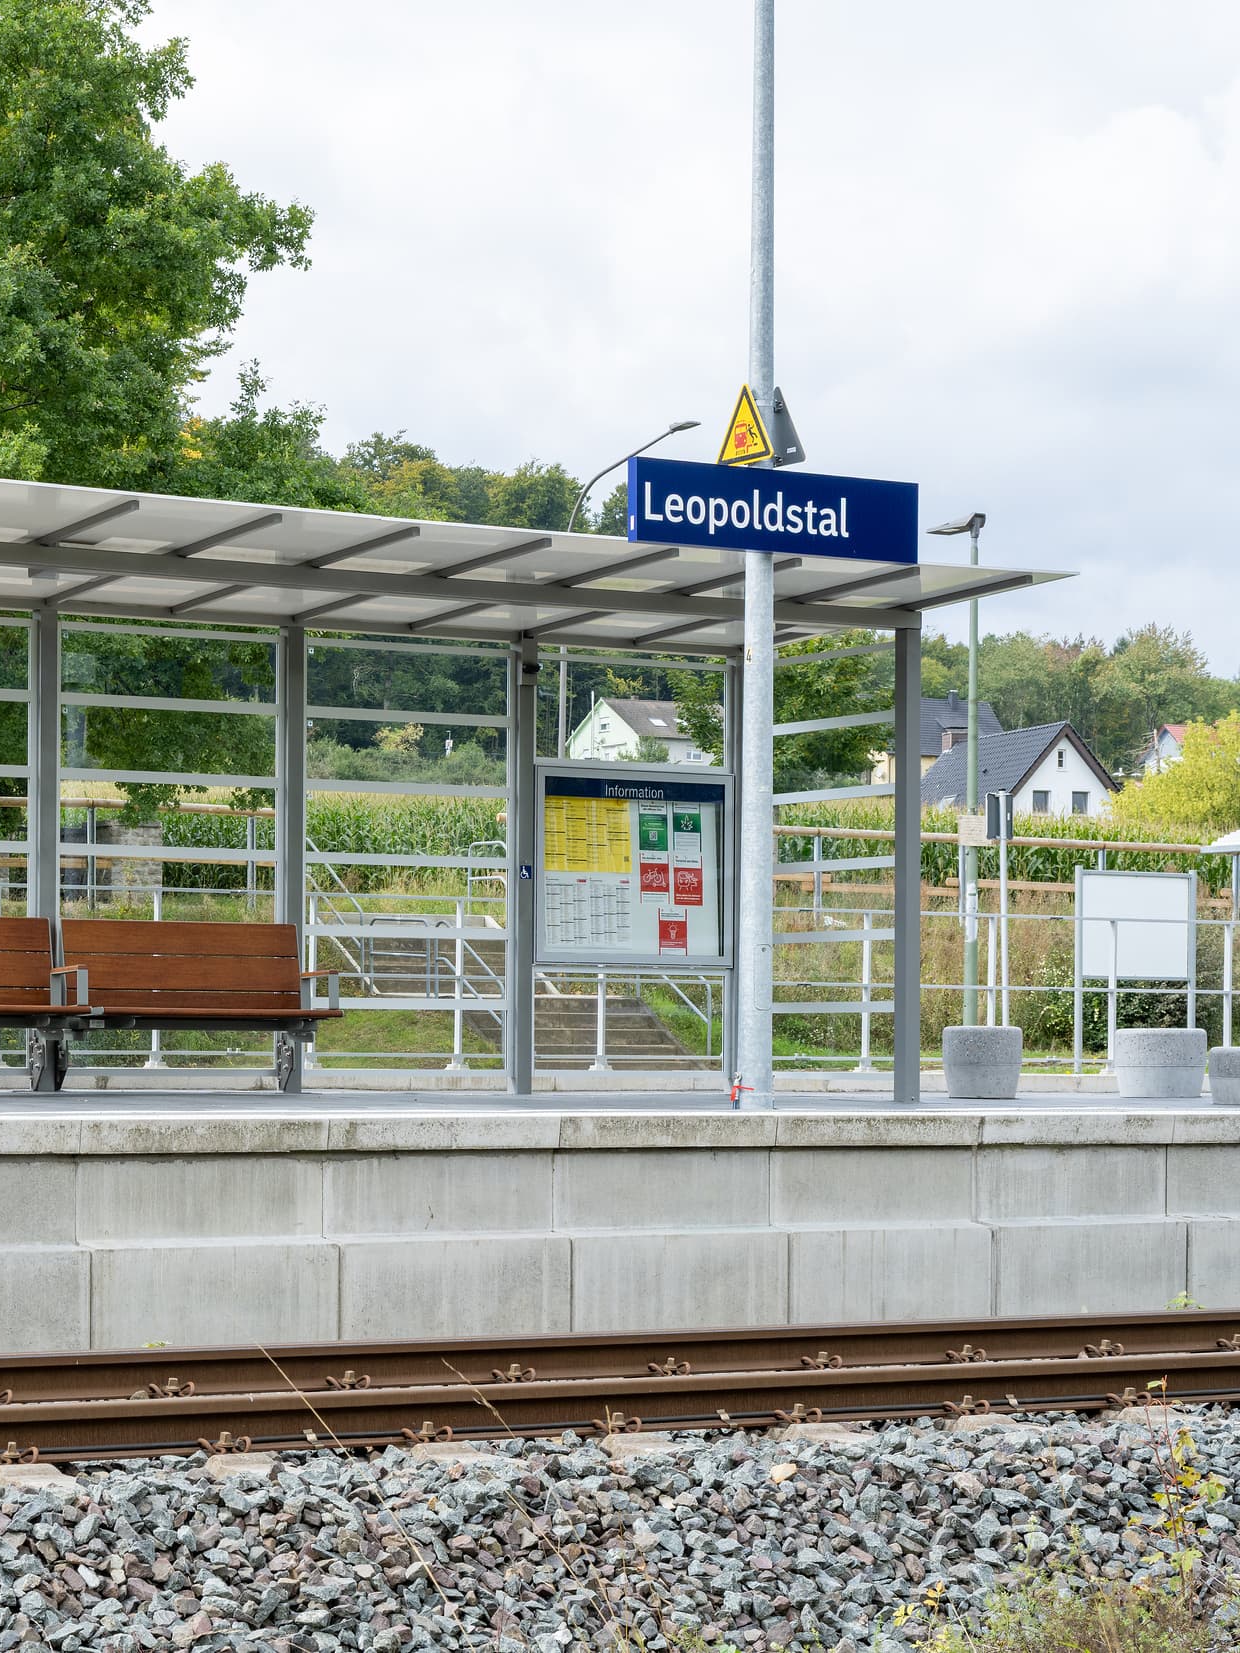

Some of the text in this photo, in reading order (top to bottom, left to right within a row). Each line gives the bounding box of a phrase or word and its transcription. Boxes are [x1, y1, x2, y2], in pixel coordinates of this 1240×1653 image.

[644, 481, 849, 538] Leopoldstal
[746, 648, 752, 663] 4
[605, 783, 664, 800] Information
